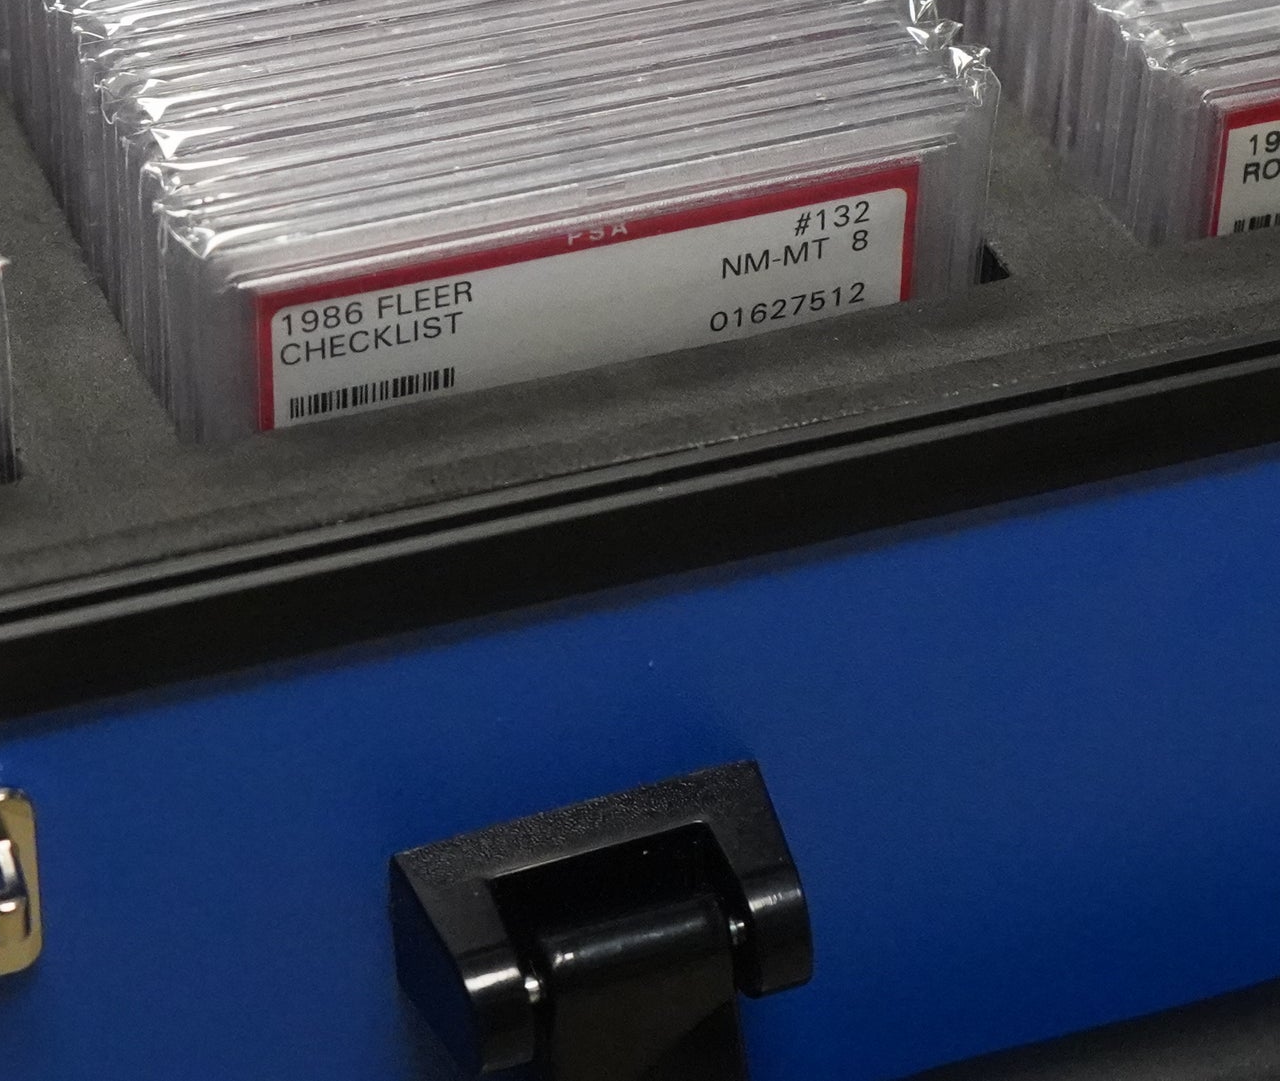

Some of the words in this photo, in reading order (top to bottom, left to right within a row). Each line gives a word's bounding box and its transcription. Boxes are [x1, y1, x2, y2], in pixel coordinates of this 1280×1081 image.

[794, 200, 871, 237] #132
[721, 237, 830, 280] NM-MT
[851, 229, 870, 252] 8
[281, 301, 364, 337] 1986
[377, 280, 473, 319] FLEER
[709, 282, 866, 333] 01627512
[280, 311, 464, 366] CHECKLIST
